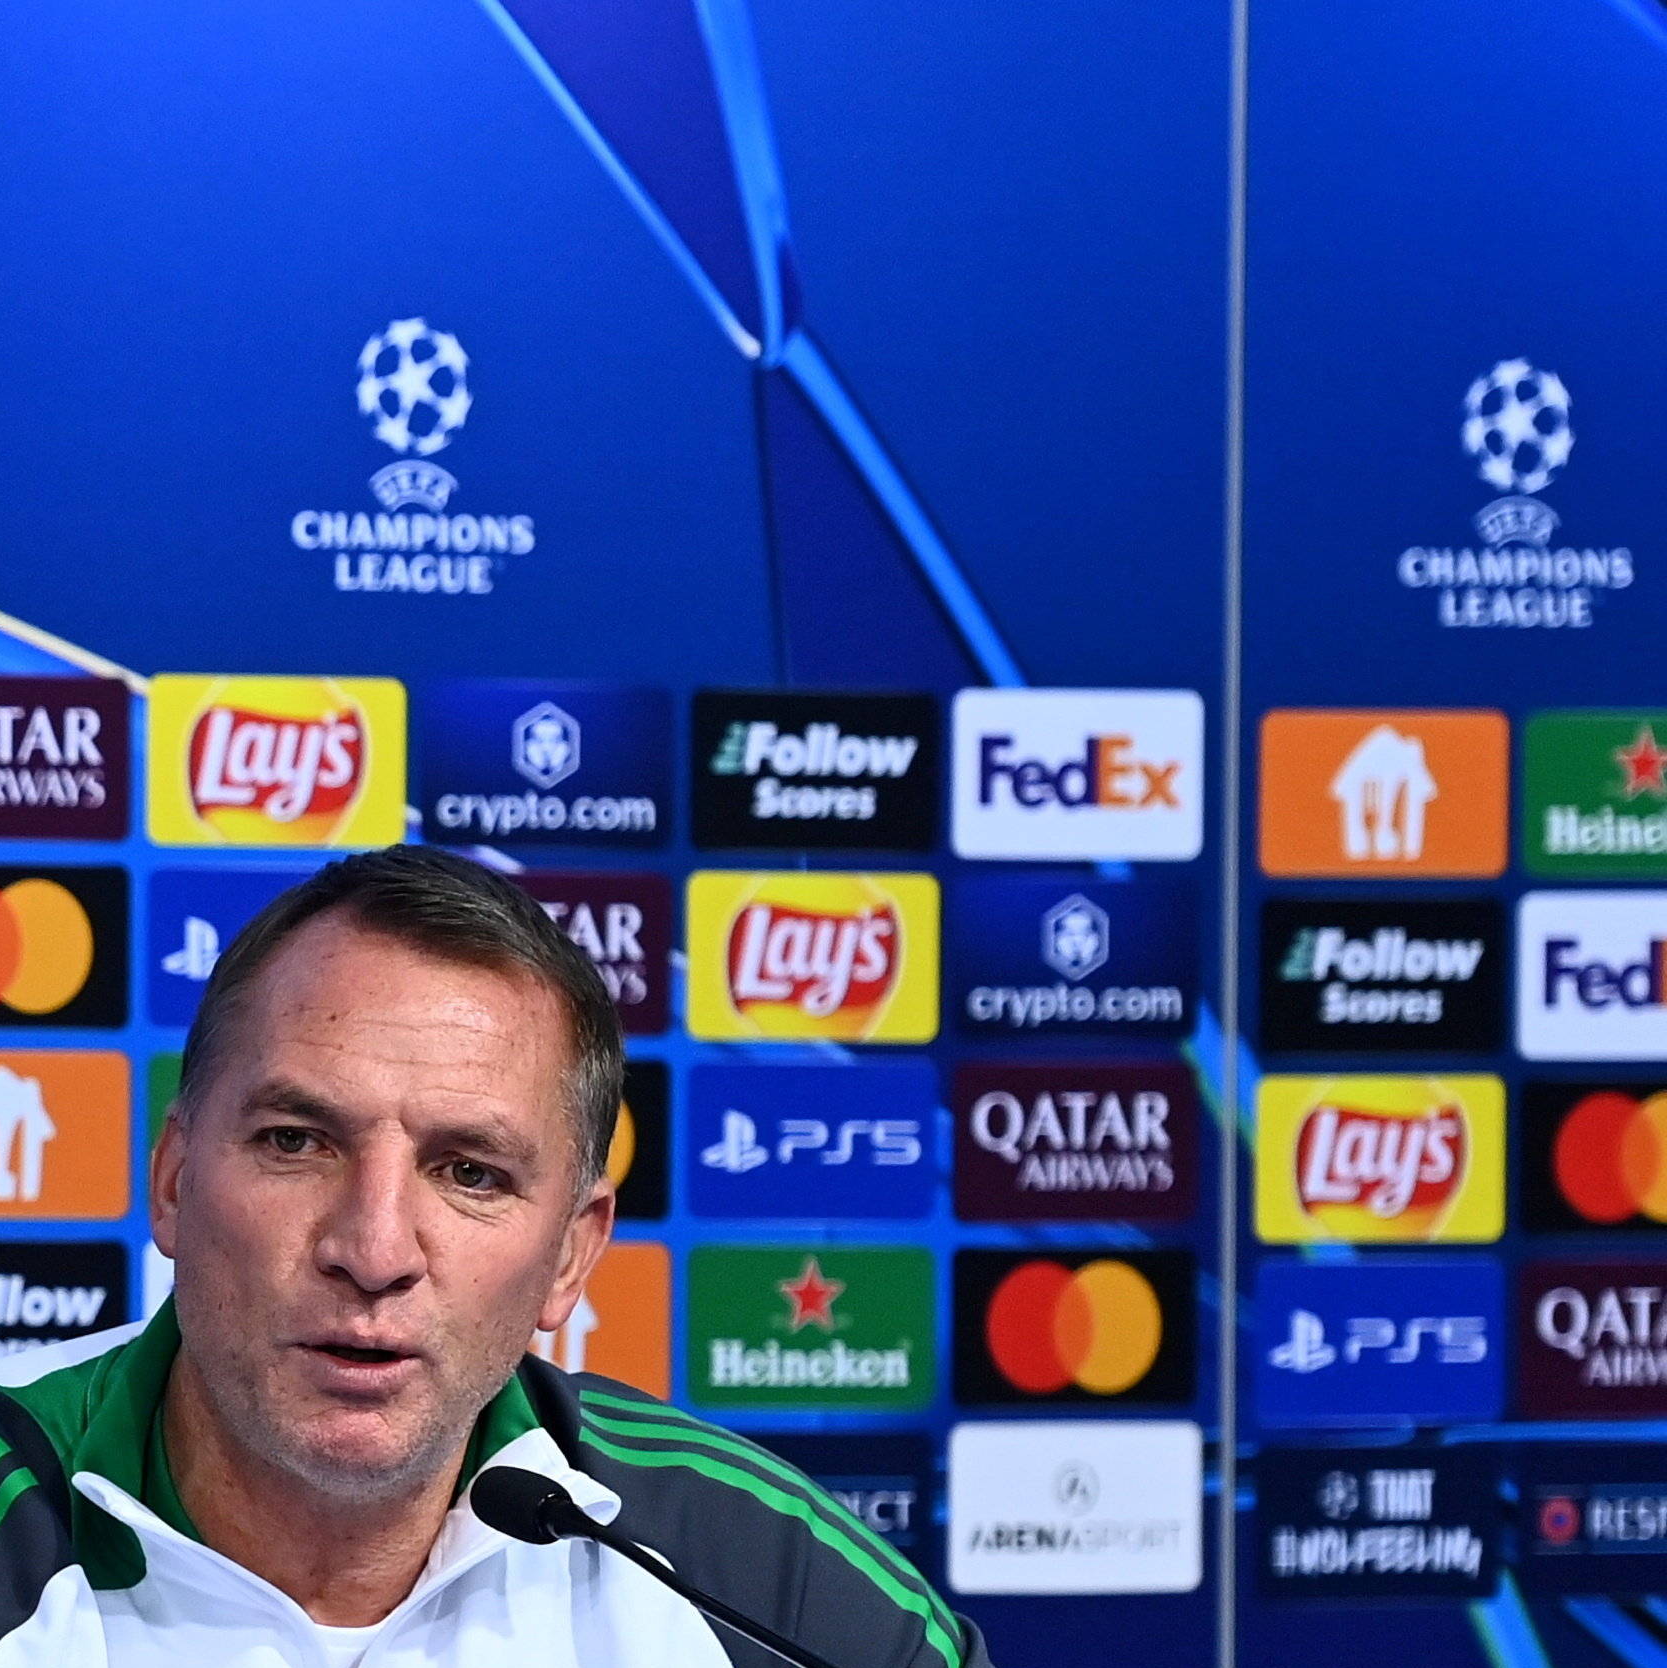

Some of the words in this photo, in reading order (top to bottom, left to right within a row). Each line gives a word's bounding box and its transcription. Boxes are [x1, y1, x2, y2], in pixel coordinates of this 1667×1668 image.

[292, 511, 534, 554] CHAMPIONS
[335, 554, 492, 594] LEAGUE
[1399, 548, 1633, 588] CHAMPIONS
[1441, 588, 1591, 627] LEAGUE
[195, 708, 361, 821] Lay's
[743, 723, 917, 774] Follow
[978, 735, 1180, 810] FedEx
[437, 792, 656, 834] crypto.com
[755, 778, 876, 819] Scores
[1544, 806, 1667, 854] Heine
[731, 905, 895, 1016] Lay's
[1310, 928, 1483, 980] Follow
[1544, 938, 1667, 1010] Fed
[969, 983, 1182, 1026] crypto.com
[778, 1120, 921, 1165] PS5
[972, 1092, 1170, 1158] QATAR
[1020, 1153, 1173, 1190] AIRWAYS
[1303, 1105, 1457, 1219] Lay's
[1345, 1317, 1487, 1363] PS5
[1537, 1287, 1667, 1359] QAT
[710, 1339, 909, 1387] Heineken
